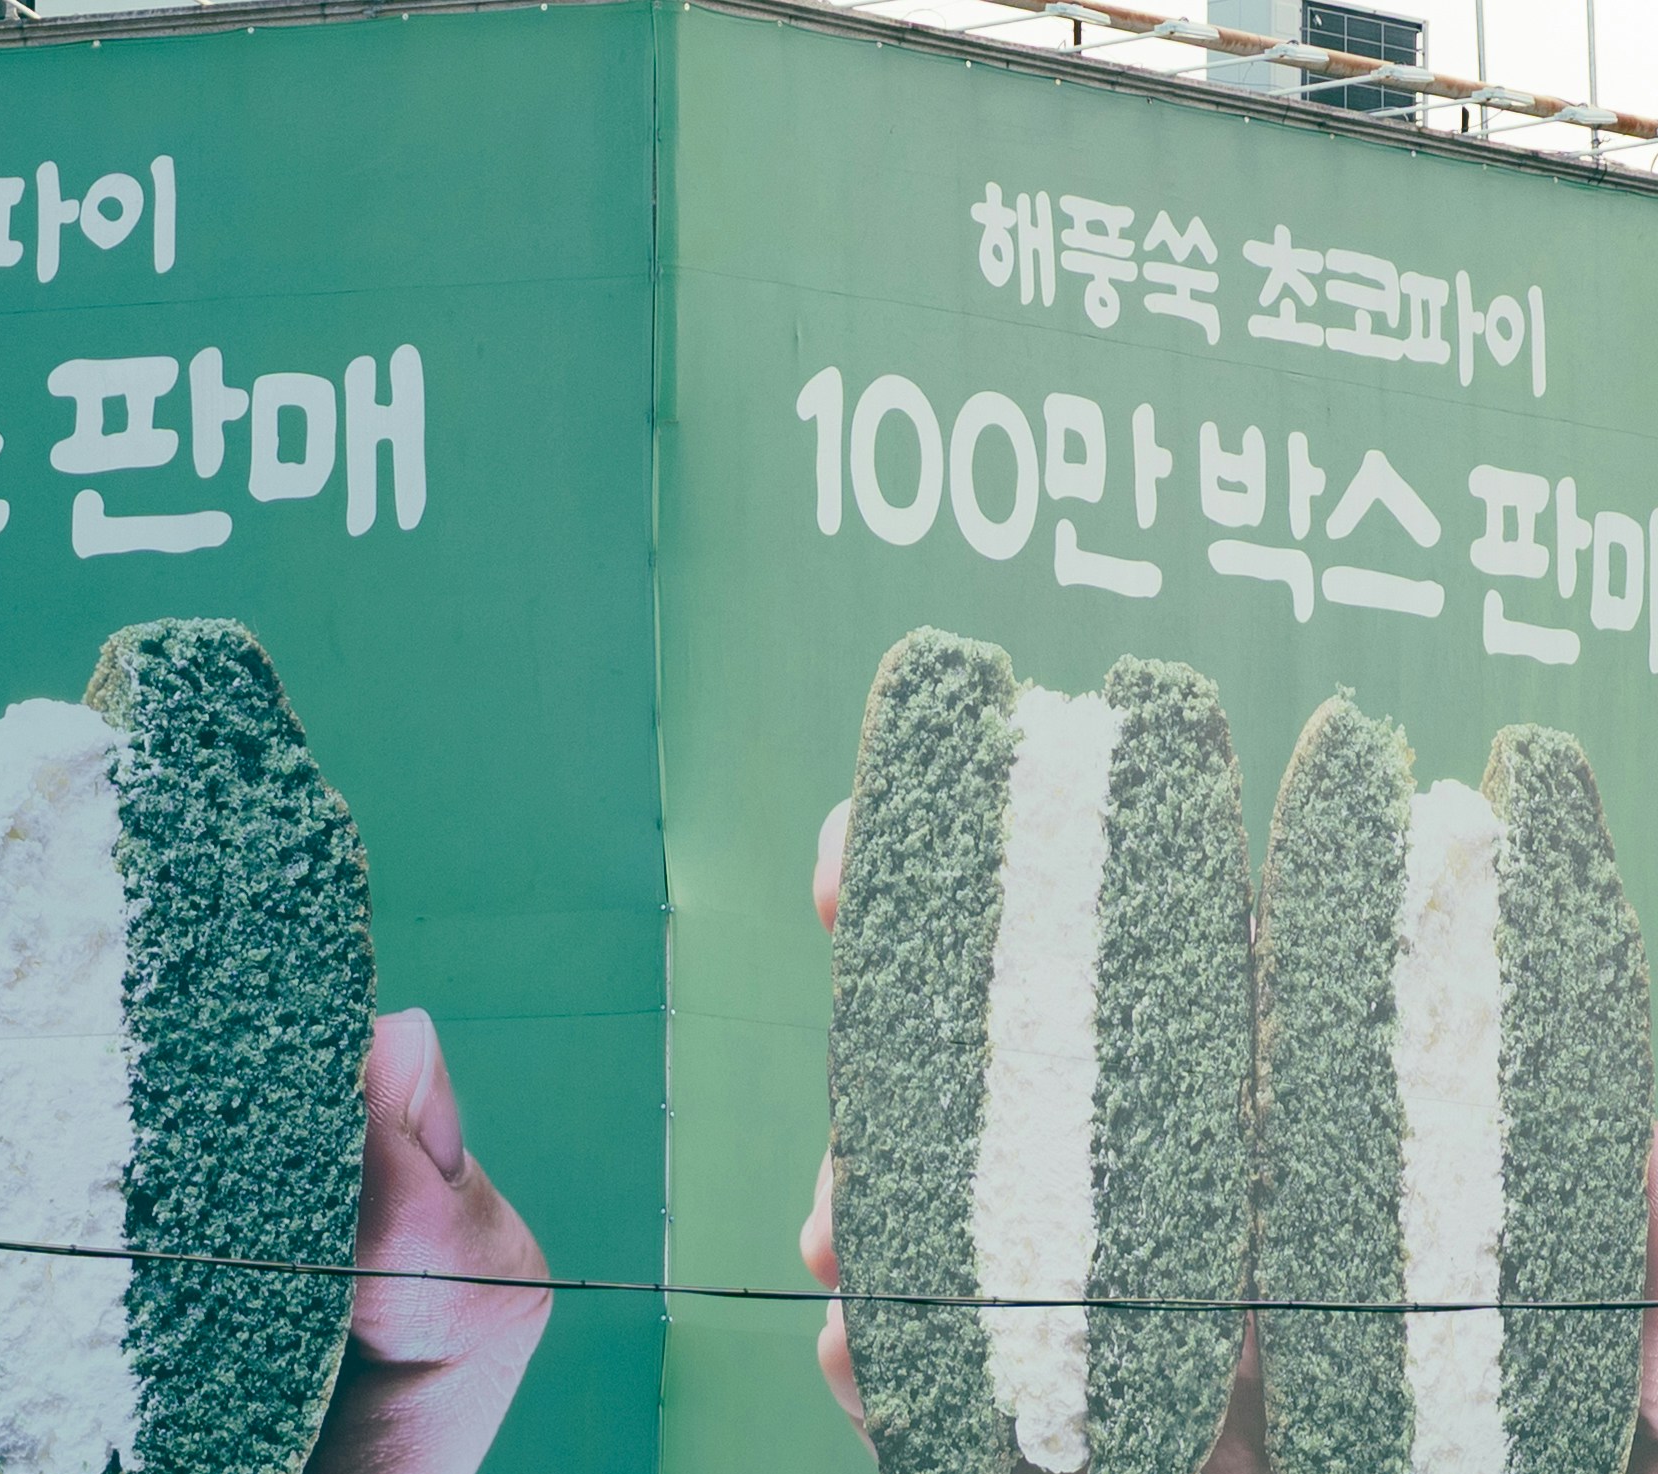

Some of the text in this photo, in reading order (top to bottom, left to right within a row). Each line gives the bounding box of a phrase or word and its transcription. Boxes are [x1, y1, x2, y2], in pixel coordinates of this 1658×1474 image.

[970, 181, 1546, 397] 해풍쑥 초코파이
[46, 342, 429, 558] 판매
[795, 364, 1164, 599] 100만
[1198, 420, 1446, 623] 박스
